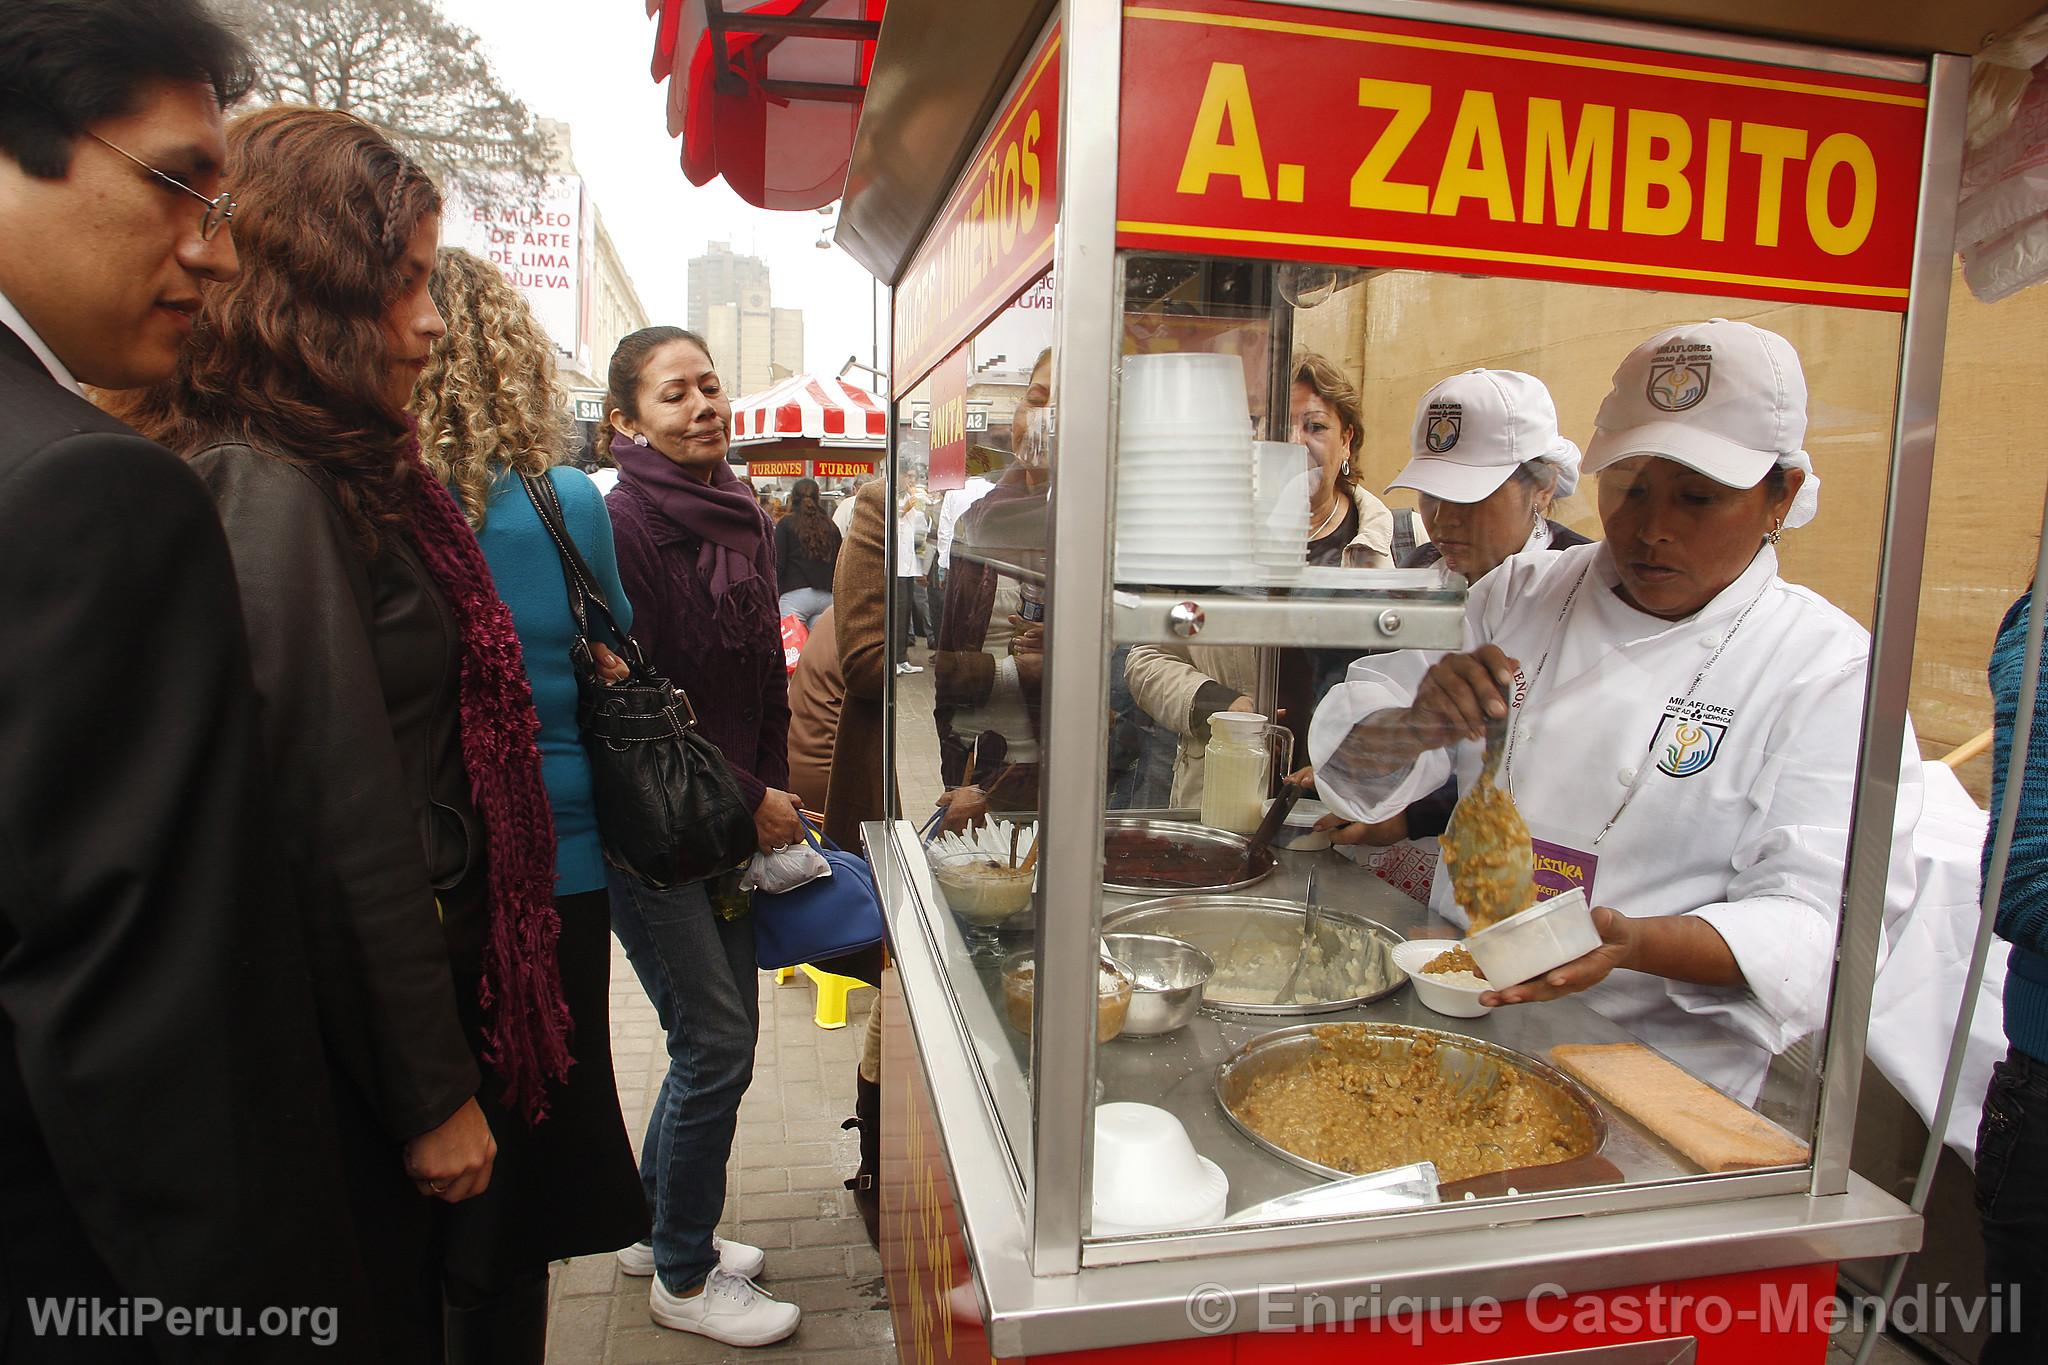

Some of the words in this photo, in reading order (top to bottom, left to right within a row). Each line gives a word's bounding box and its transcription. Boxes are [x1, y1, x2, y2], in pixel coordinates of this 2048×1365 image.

[1176, 62, 1304, 203] A.
[1350, 77, 1878, 256] ZAMBITO
[500, 208, 571, 227] MUSEO
[523, 232, 570, 248] ARTE
[521, 252, 570, 269] LIMA
[504, 271, 569, 289] NUEVA
[930, 394, 964, 450] ANITA
[752, 462, 802, 475] TURRONES
[819, 463, 869, 475] TURRON
